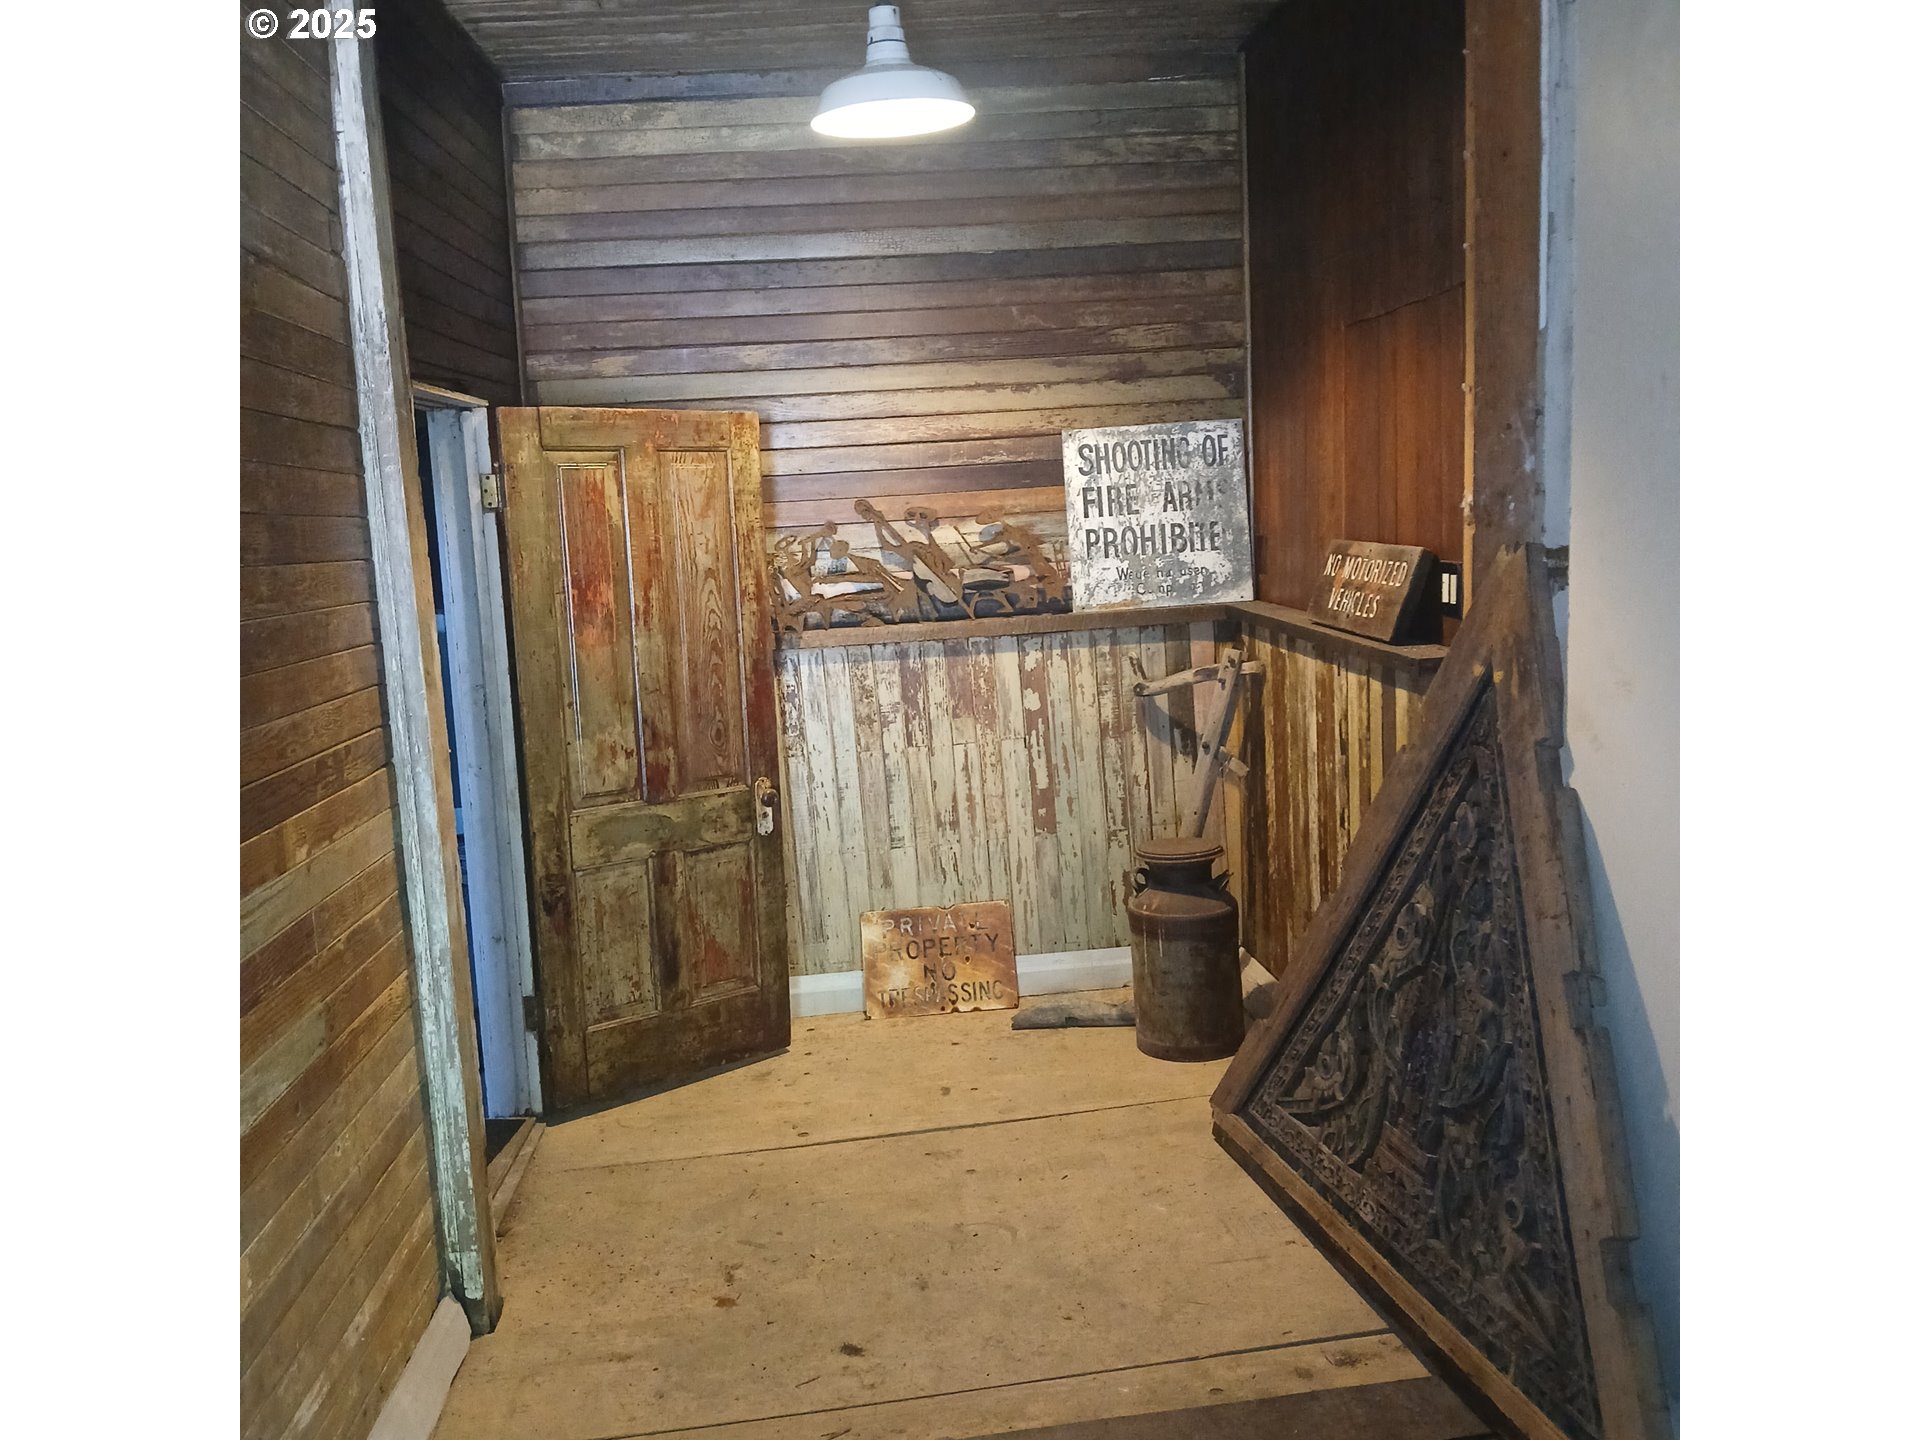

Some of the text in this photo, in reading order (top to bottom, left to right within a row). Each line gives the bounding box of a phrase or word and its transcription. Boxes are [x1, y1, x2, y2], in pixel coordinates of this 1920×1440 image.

[1078, 434, 1229, 477] SHOOTING OF
[1082, 484, 1140, 519] FIRE
[1085, 521, 1225, 559] PROHIBITE
[1323, 553, 1409, 588] NO MOTORIZED
[1327, 587, 1381, 619] VEHICLES
[873, 933, 999, 962] PROPERTY
[924, 961, 957, 982] NO
